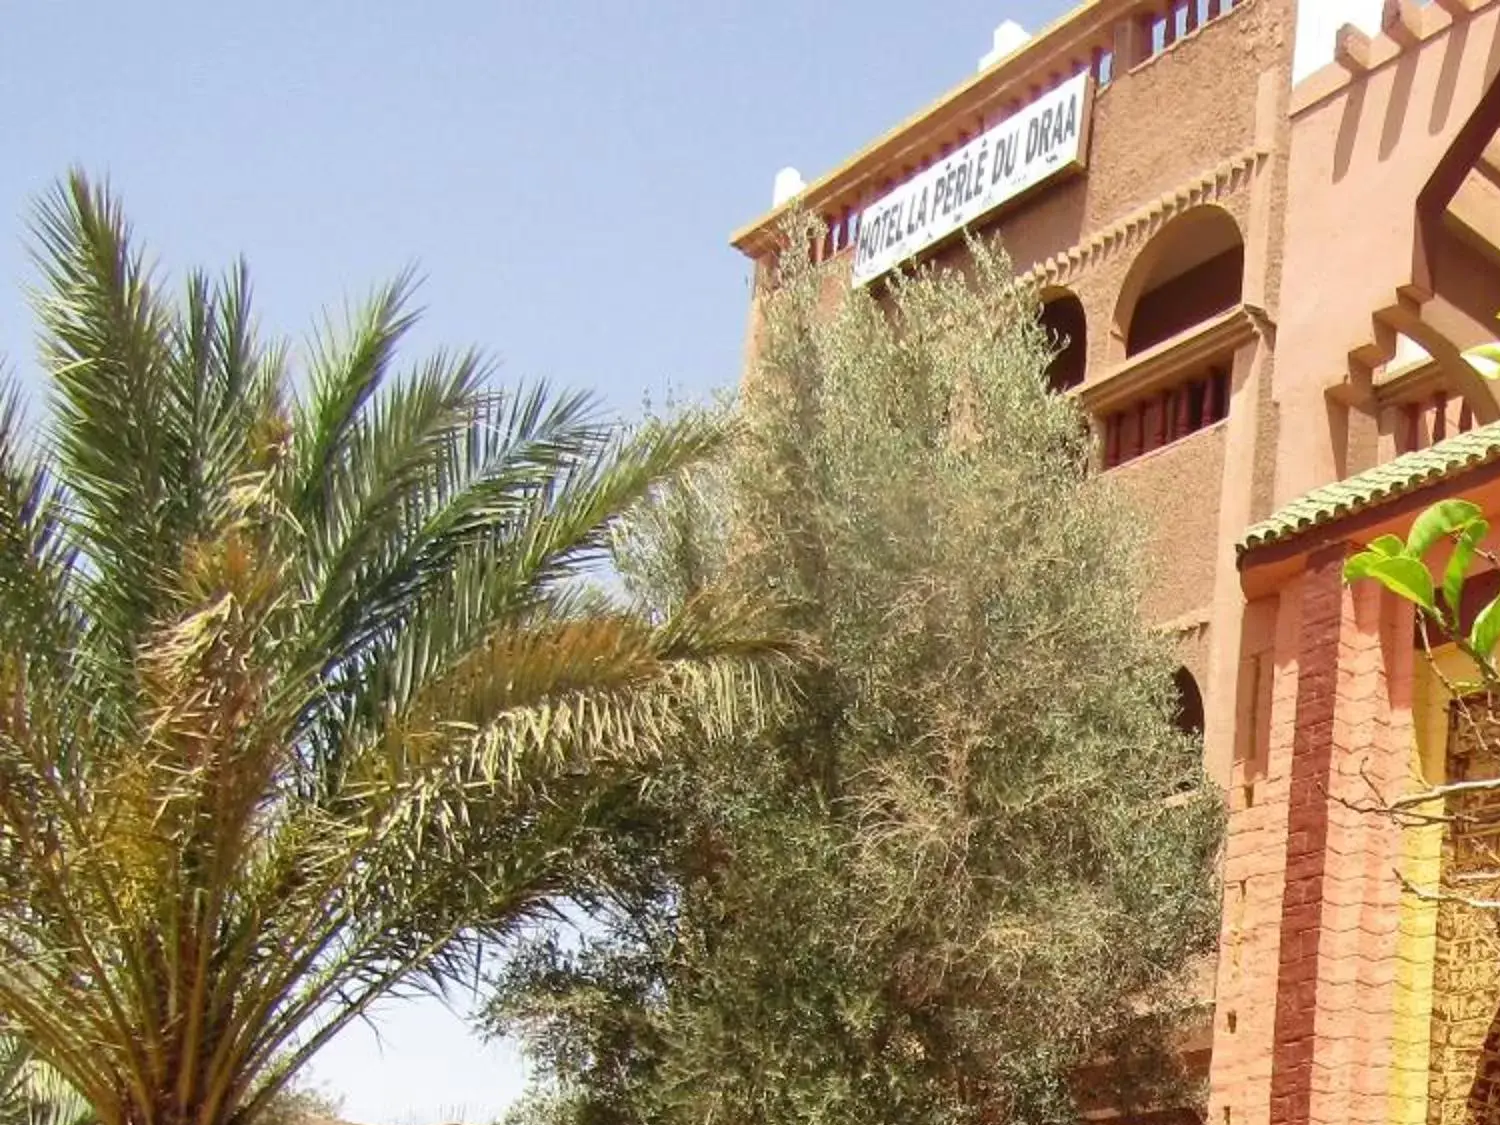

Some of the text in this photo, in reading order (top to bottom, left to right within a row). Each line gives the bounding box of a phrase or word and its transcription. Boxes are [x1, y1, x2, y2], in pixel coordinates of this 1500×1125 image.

[858, 200, 904, 266] HOTEL
[907, 186, 928, 235] LA
[991, 127, 1020, 185] DU
[1025, 93, 1077, 165] DRAA
